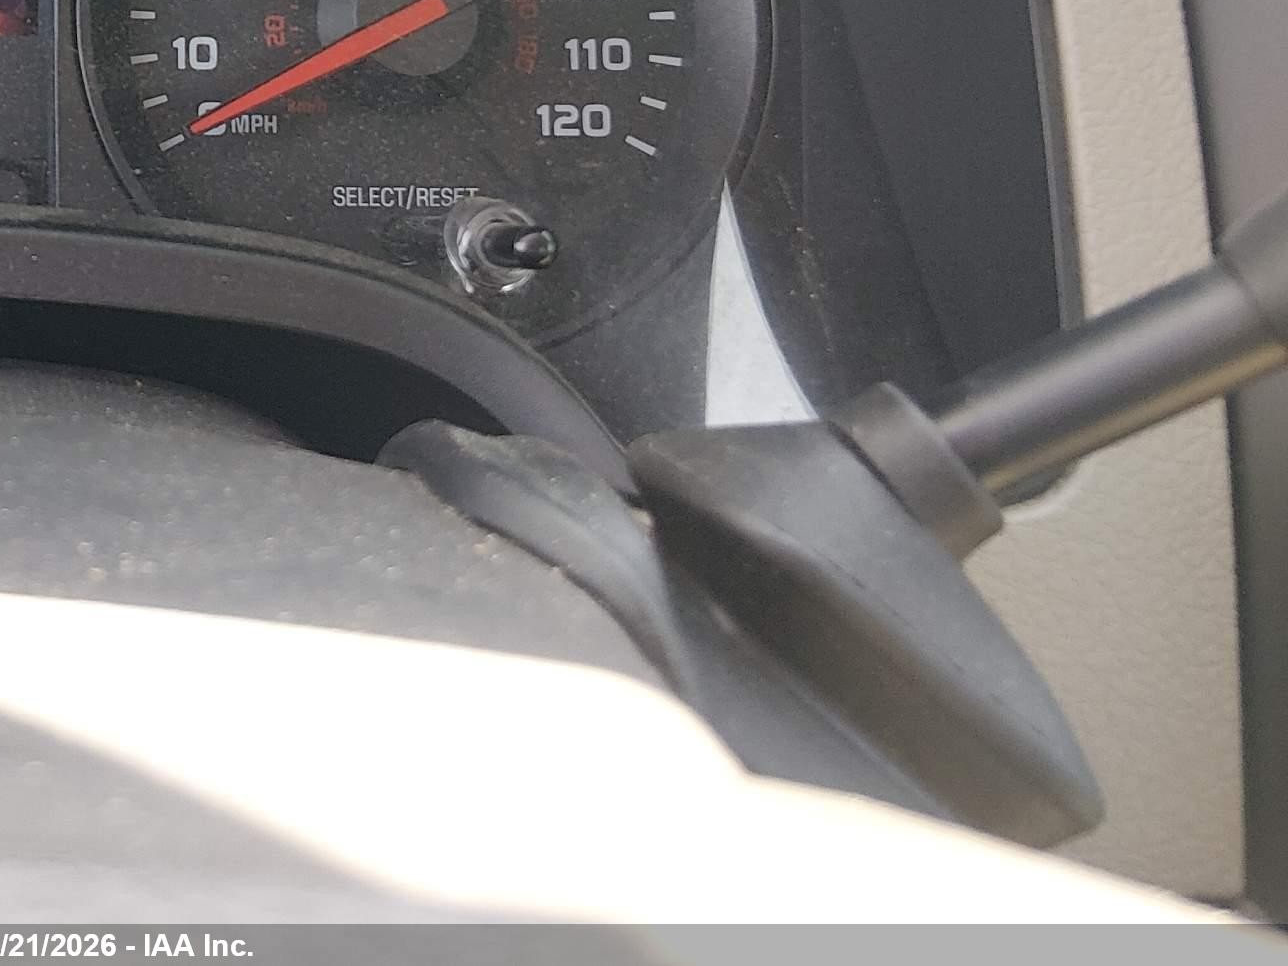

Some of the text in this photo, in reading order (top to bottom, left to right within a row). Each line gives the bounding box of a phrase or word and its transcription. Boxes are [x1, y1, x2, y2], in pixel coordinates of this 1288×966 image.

[264, 14, 286, 48] 20
[172, 37, 218, 71] 10
[565, 38, 631, 72] 110
[231, 115, 278, 134] MPH
[537, 104, 611, 138] 120
